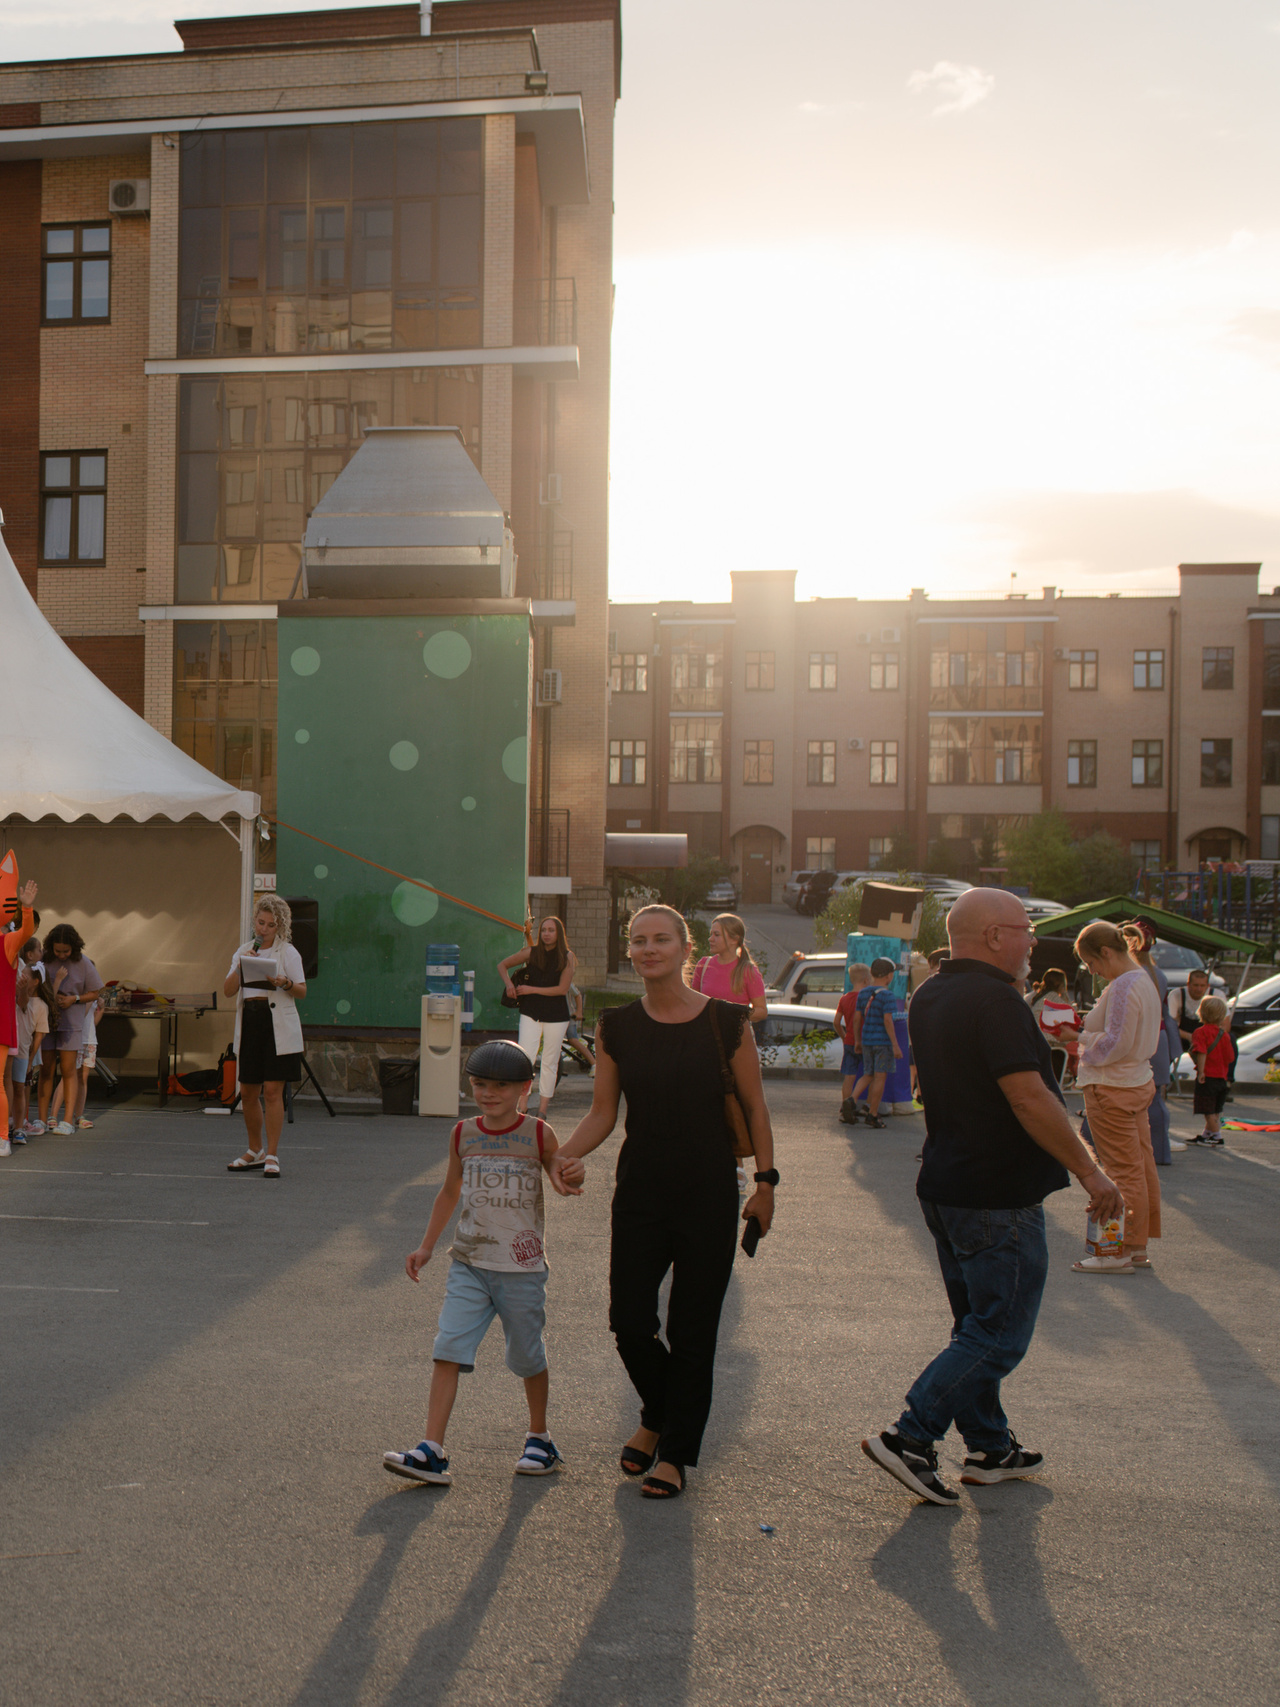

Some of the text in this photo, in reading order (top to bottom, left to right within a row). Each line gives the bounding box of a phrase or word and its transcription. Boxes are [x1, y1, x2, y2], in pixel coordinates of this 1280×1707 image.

[469, 1189, 534, 1210] Guide
[512, 1239, 534, 1252] MADE
[515, 1246, 543, 1262] BRAZIL
